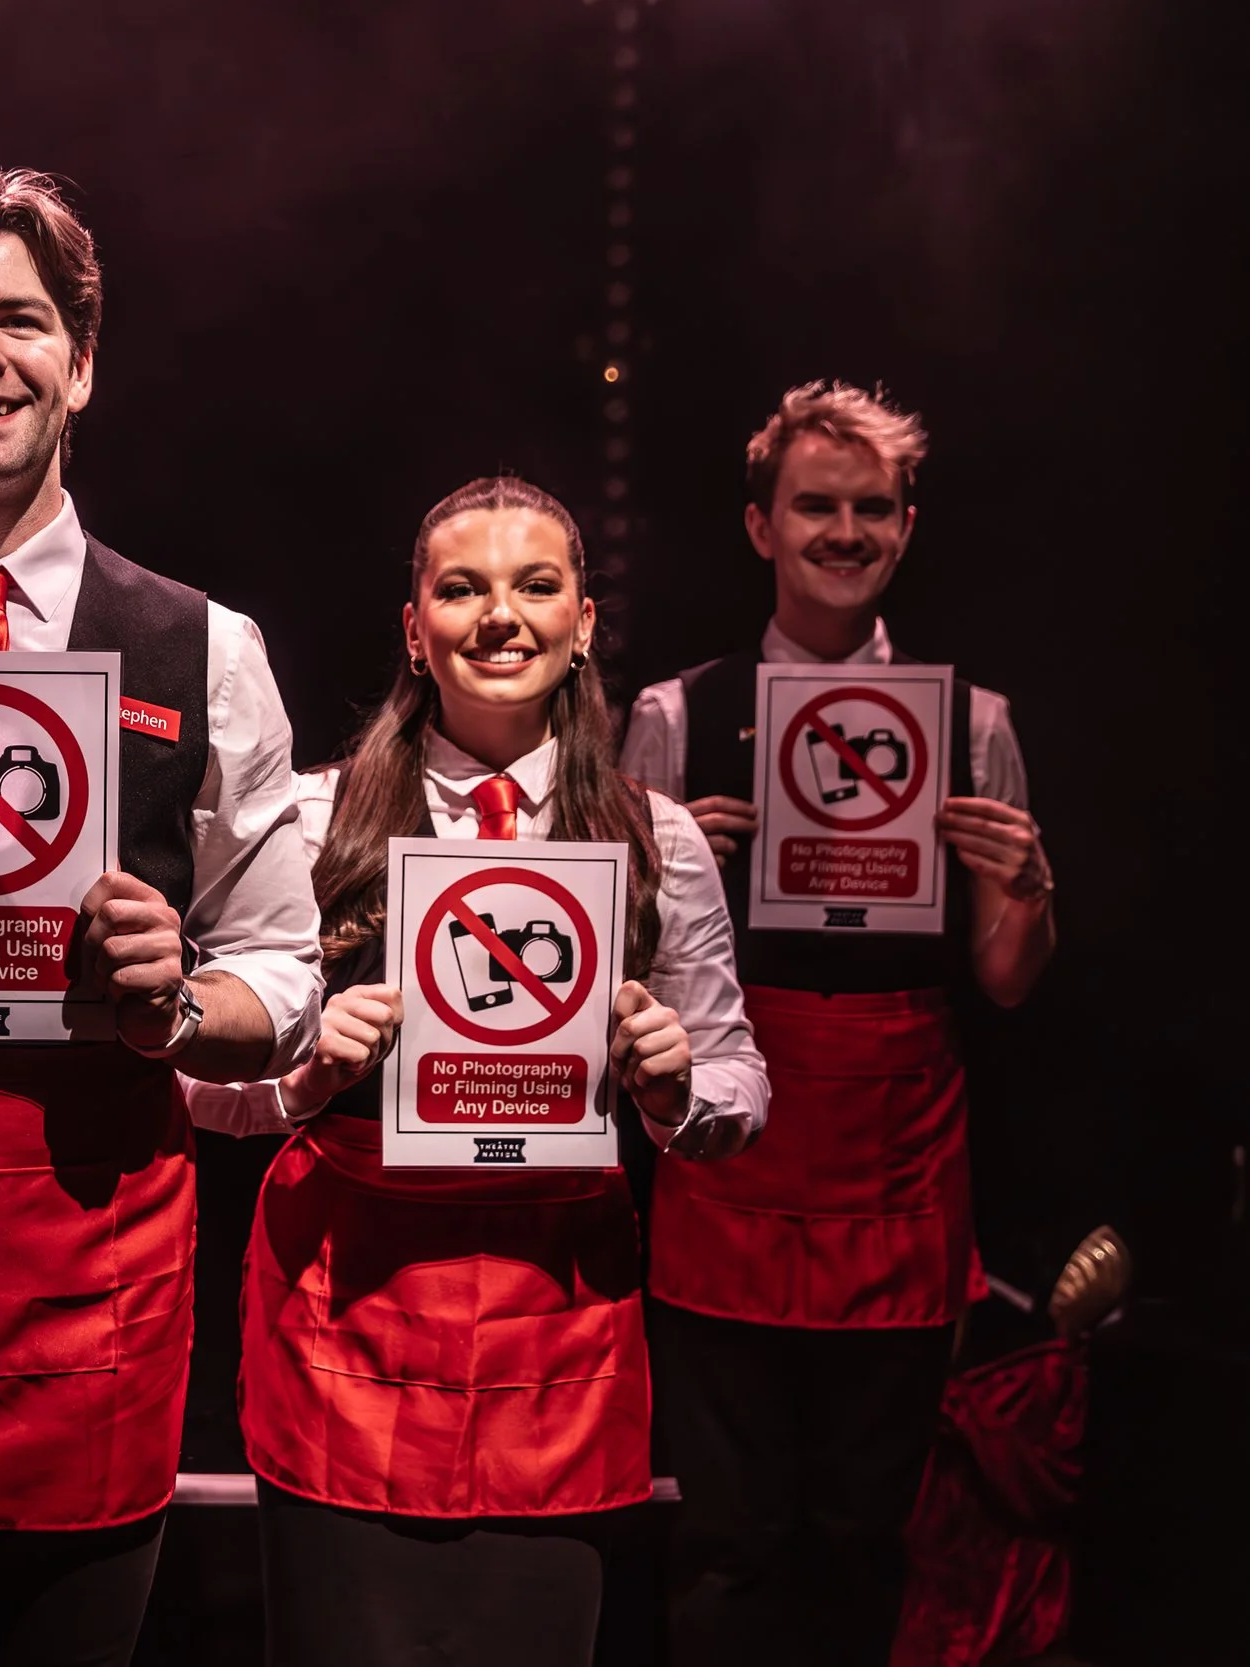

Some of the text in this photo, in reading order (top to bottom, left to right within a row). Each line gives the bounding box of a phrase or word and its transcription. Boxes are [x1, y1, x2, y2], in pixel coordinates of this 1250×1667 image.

[119, 707, 168, 731] ephen
[791, 843, 908, 861] No Photography
[790, 860, 908, 878] or Filming Using
[809, 876, 889, 892] Any Device
[6, 940, 64, 961] Using
[433, 1060, 573, 1079] No Photography
[431, 1080, 572, 1098] or Filming Using
[453, 1099, 550, 1118] Any Device
